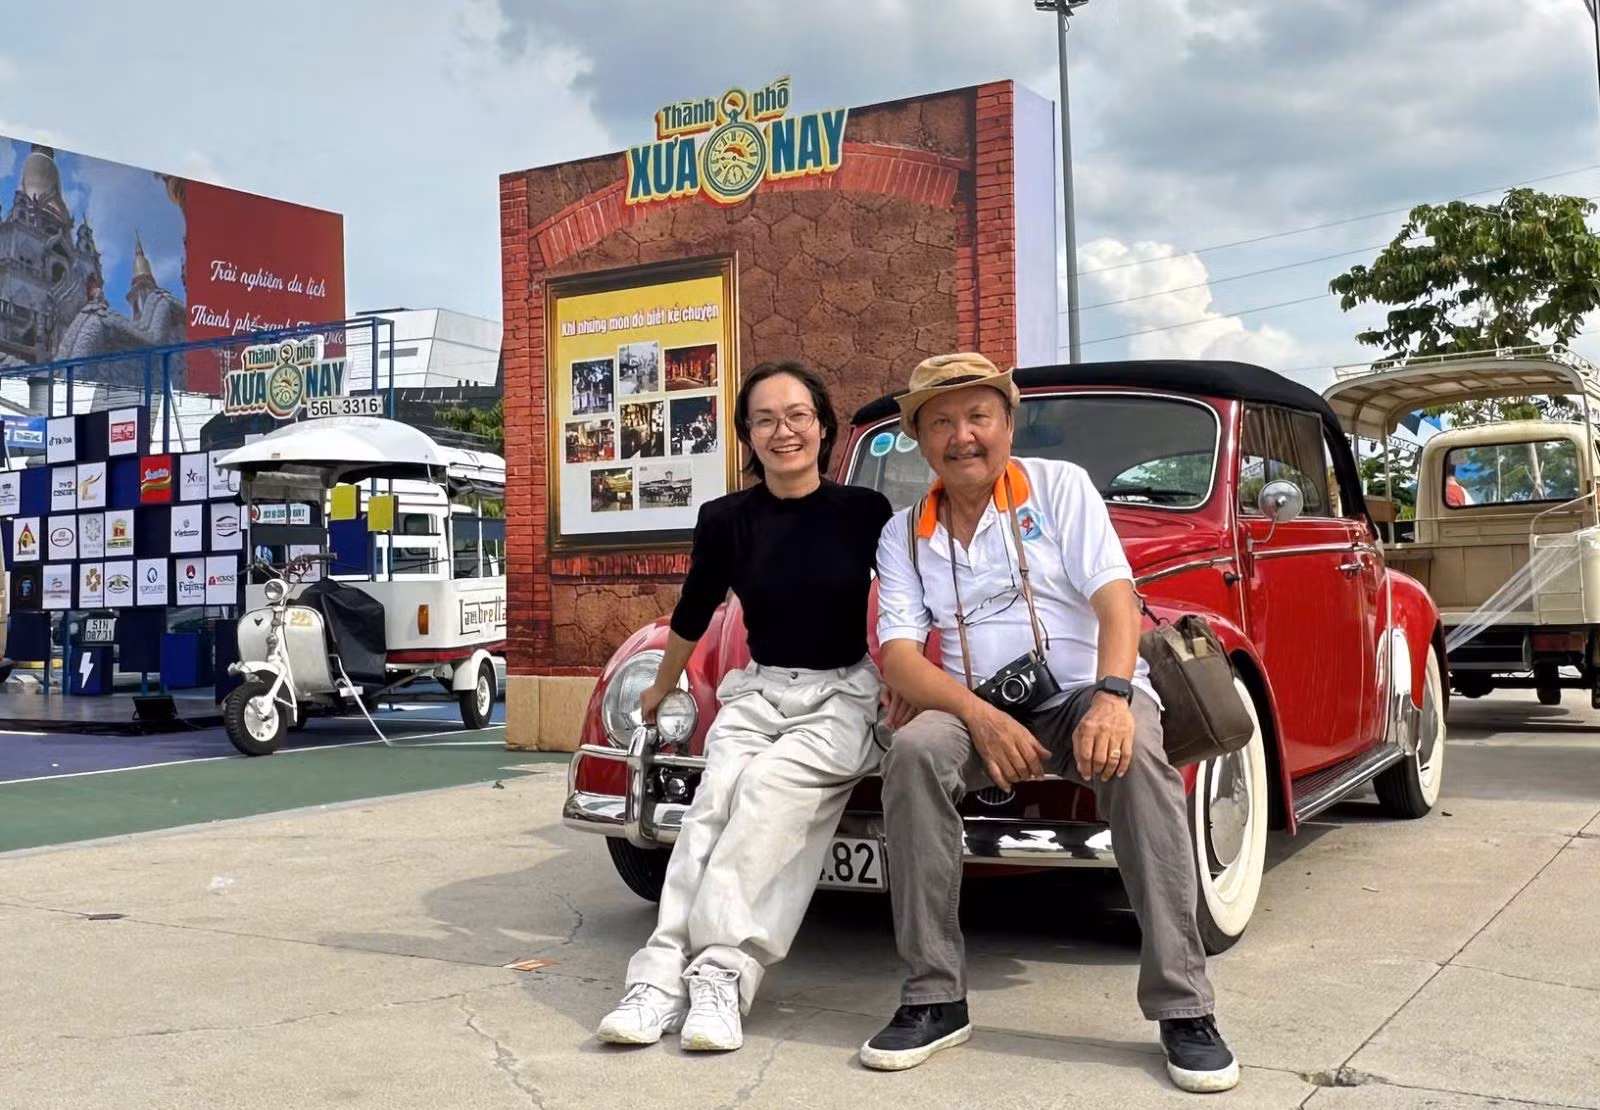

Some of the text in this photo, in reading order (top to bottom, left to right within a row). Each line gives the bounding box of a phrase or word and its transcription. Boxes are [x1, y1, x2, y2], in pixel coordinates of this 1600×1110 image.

[662, 76, 790, 130] Thành phố
[631, 109, 846, 199] XƯA NAY
[210, 259, 327, 300] Trải nghiệm du lịch
[191, 304, 231, 329] Thành
[247, 340, 317, 366] Thành phố
[230, 361, 345, 407] XƯA NAY
[311, 397, 379, 416] 56L 3316
